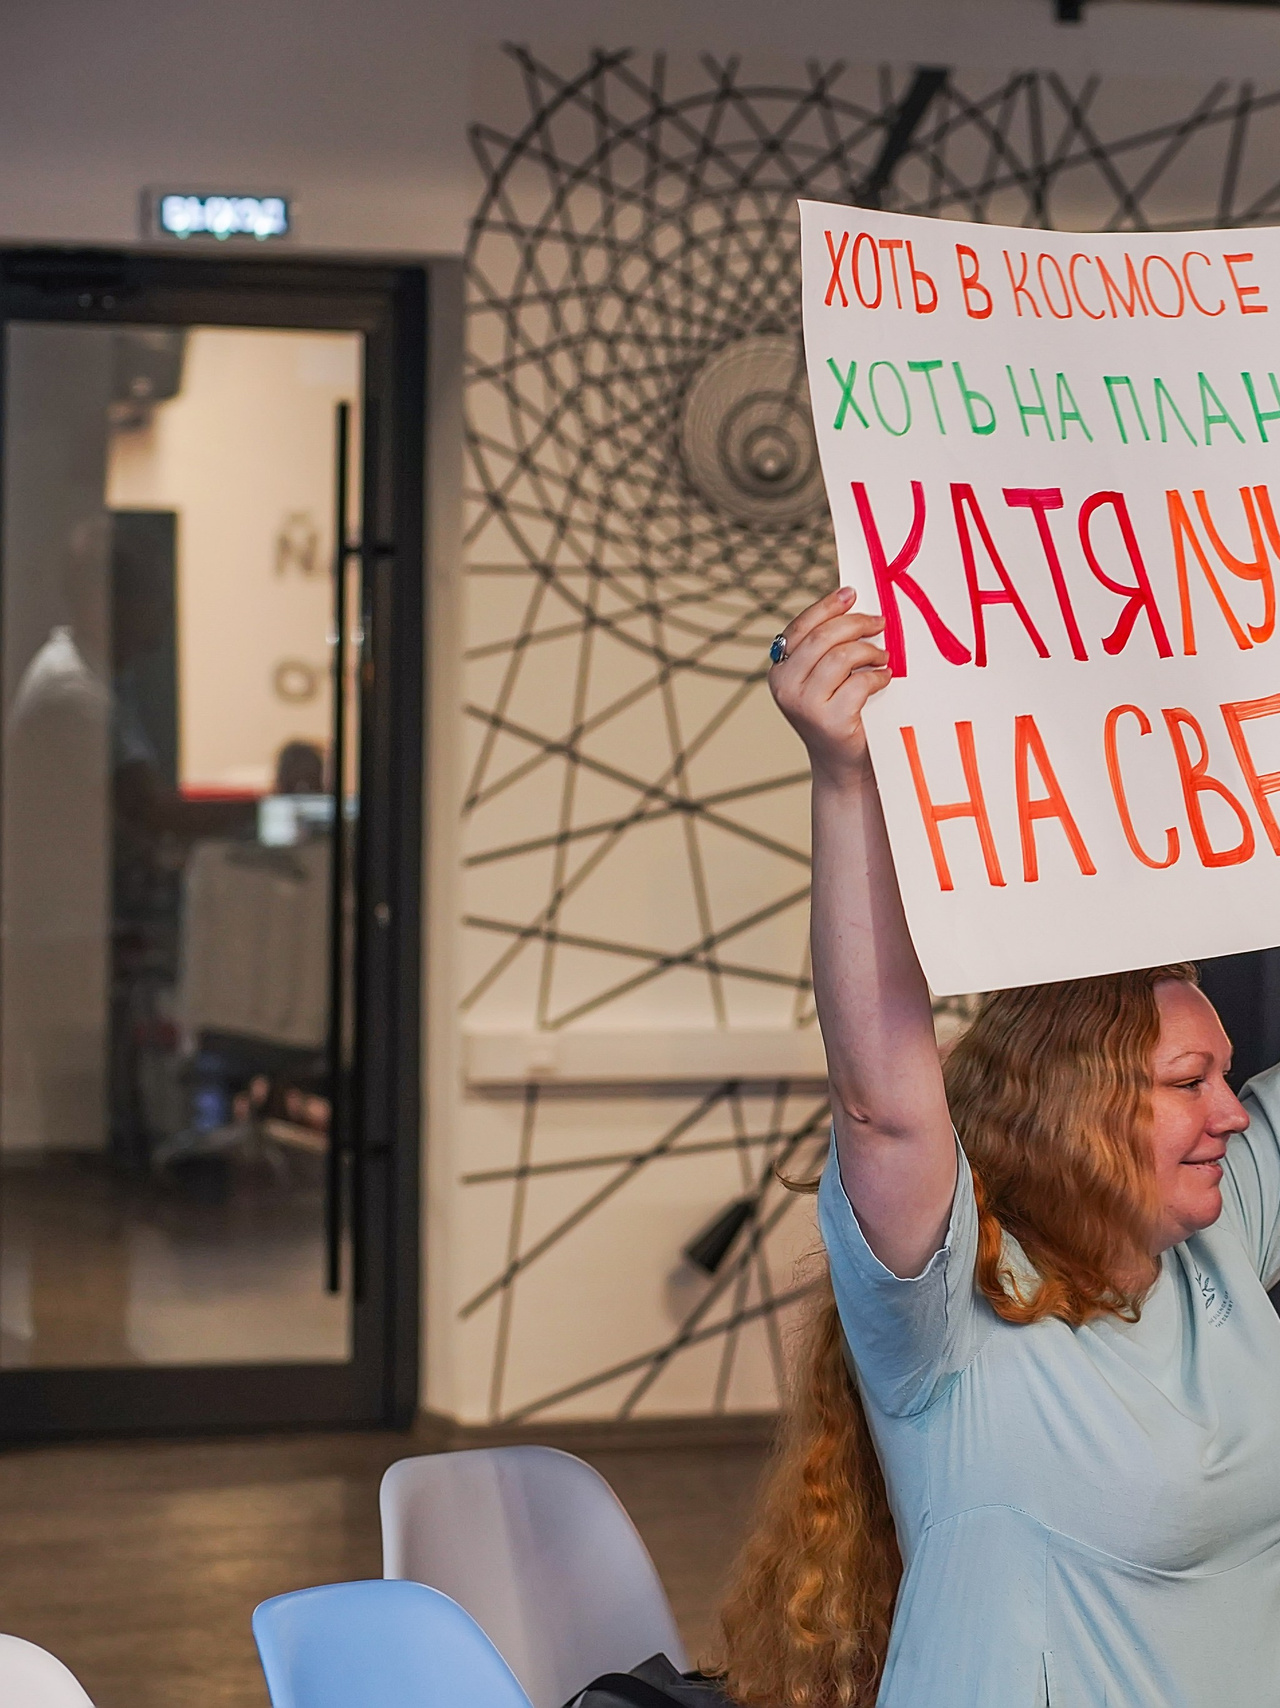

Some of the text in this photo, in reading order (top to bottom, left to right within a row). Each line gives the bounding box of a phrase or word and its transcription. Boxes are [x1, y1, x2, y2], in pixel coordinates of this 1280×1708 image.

[823, 229, 1269, 320] ХОТЬ В КОСМОСЕ
[828, 357, 998, 436] ХОТЬ
[1006, 365, 1093, 443] НА
[850, 480, 1175, 678] КАТЯ
[899, 714, 1098, 892] НА
